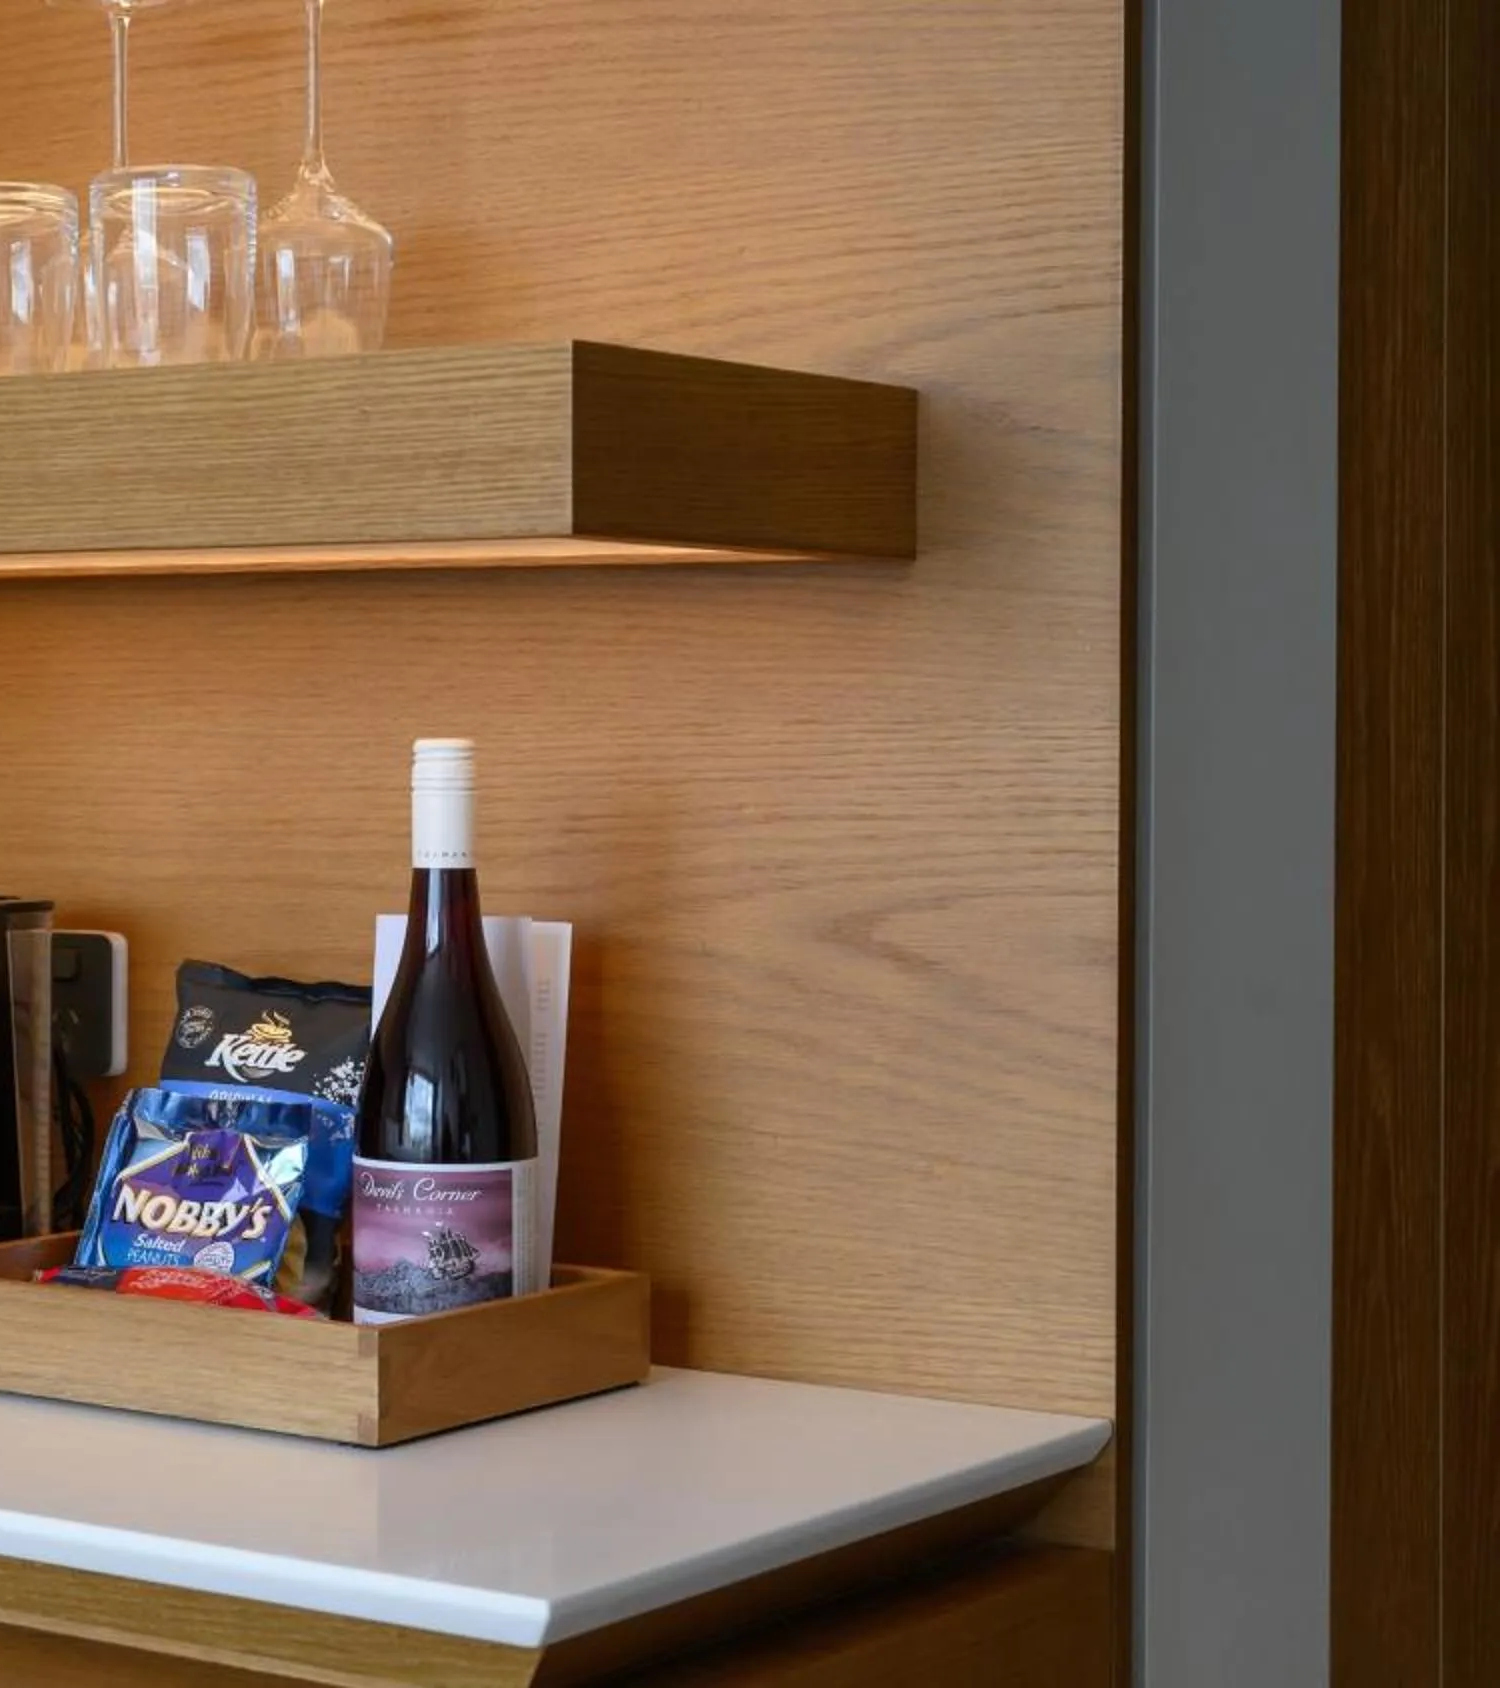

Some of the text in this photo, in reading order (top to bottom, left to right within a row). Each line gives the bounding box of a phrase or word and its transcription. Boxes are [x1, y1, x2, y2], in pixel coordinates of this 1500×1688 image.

[204, 1033, 308, 1083] Kettle
[413, 1177, 484, 1201] Corner
[112, 1184, 273, 1239] NOBBY'S
[376, 1203, 454, 1215] TASMANIA
[133, 1233, 187, 1252] Salted
[126, 1249, 181, 1266] PEANUTS
